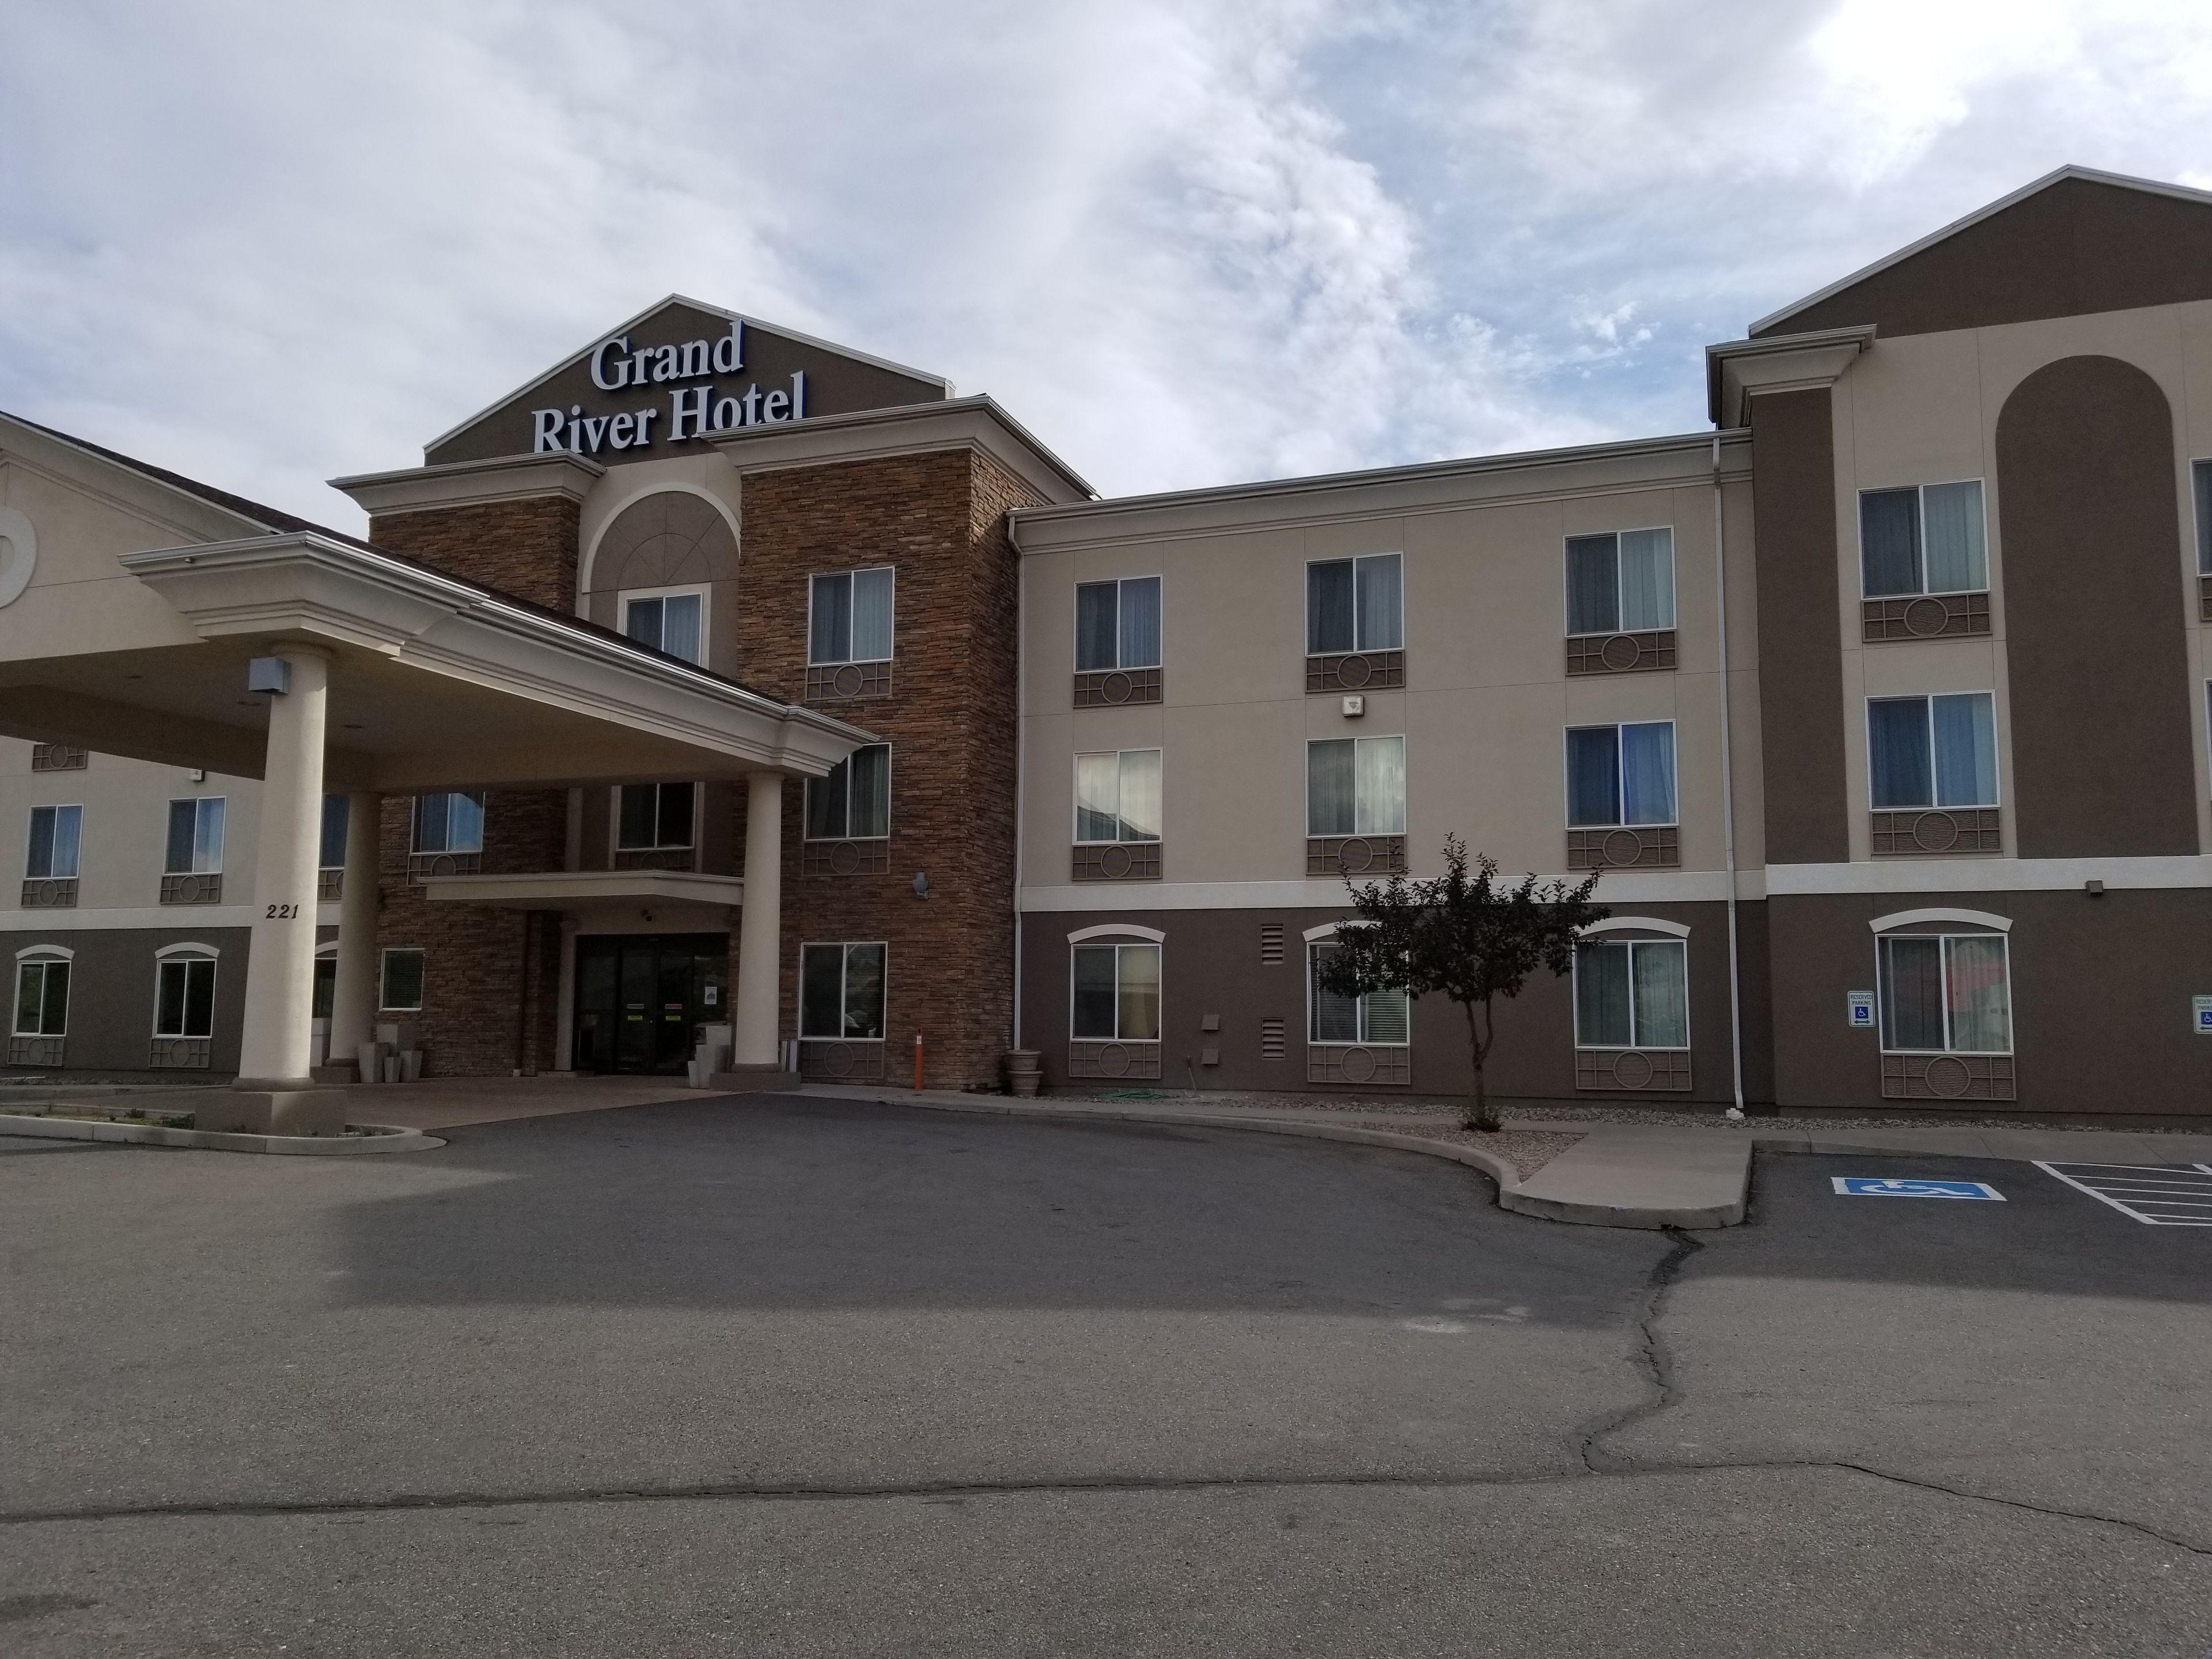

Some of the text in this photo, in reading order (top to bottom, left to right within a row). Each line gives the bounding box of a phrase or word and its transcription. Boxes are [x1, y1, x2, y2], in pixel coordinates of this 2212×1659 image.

[590, 318, 745, 391] Grand
[531, 370, 805, 454] River Hotel
[266, 904, 298, 919] 221
